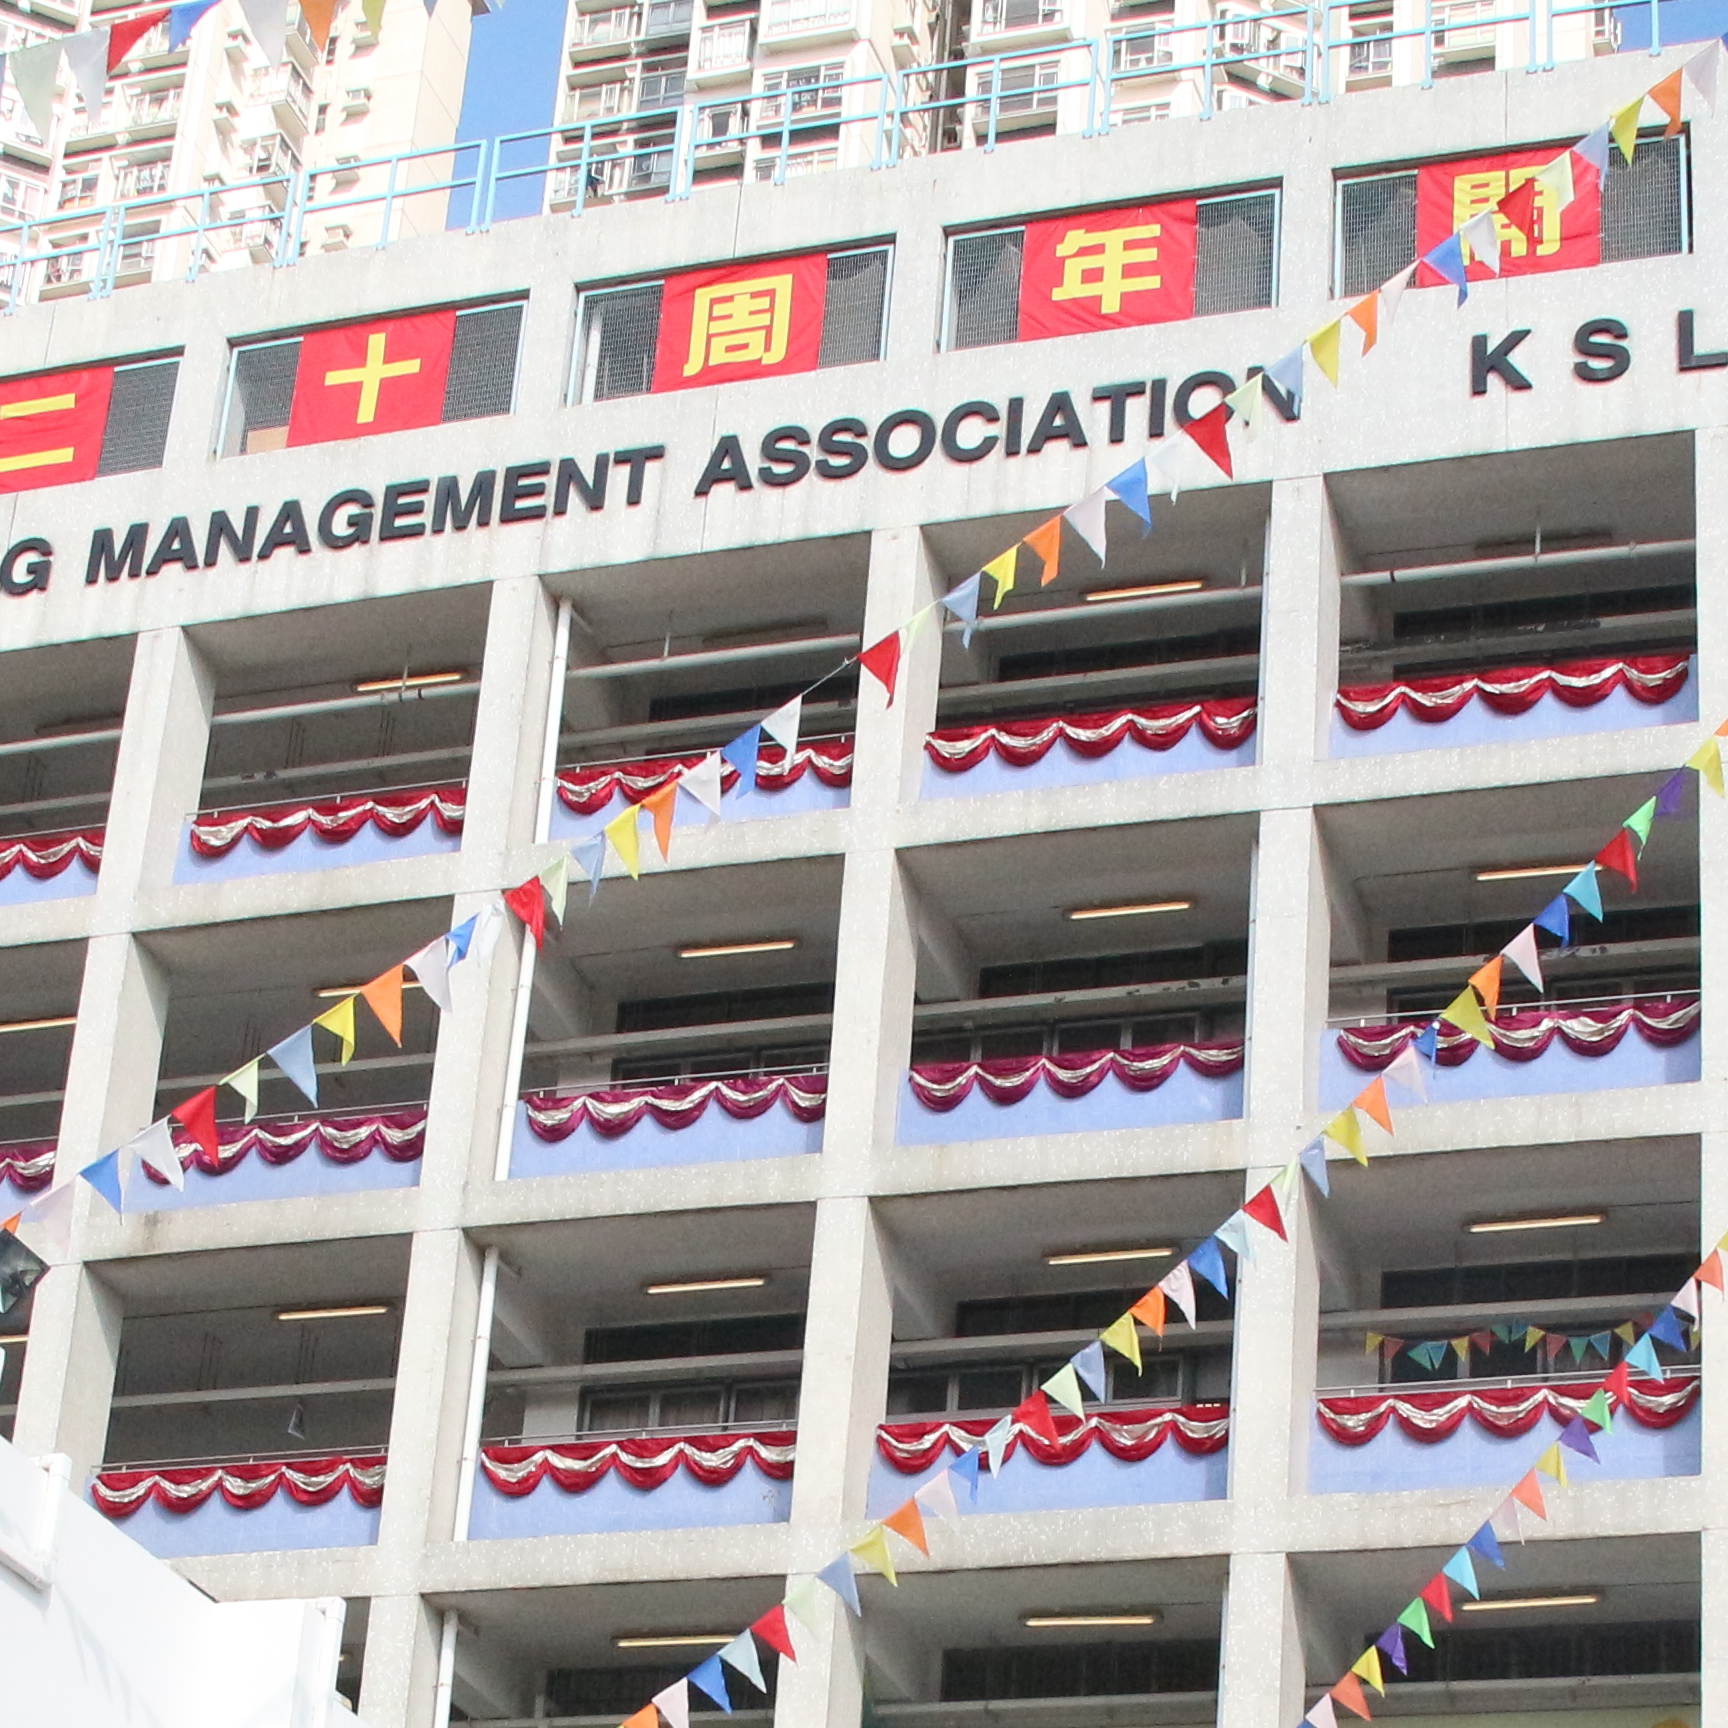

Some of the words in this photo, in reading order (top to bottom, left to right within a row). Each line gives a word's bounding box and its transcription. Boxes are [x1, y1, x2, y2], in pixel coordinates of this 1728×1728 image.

[323, 333, 420, 424] 十
[683, 273, 795, 378] 周
[1051, 223, 1162, 315] 年
[1470, 327, 1534, 396] K
[1572, 317, 1632, 383] S
[84, 443, 665, 585] MANAGEMENT
[693, 365, 1302, 497] ASSOCIATION
